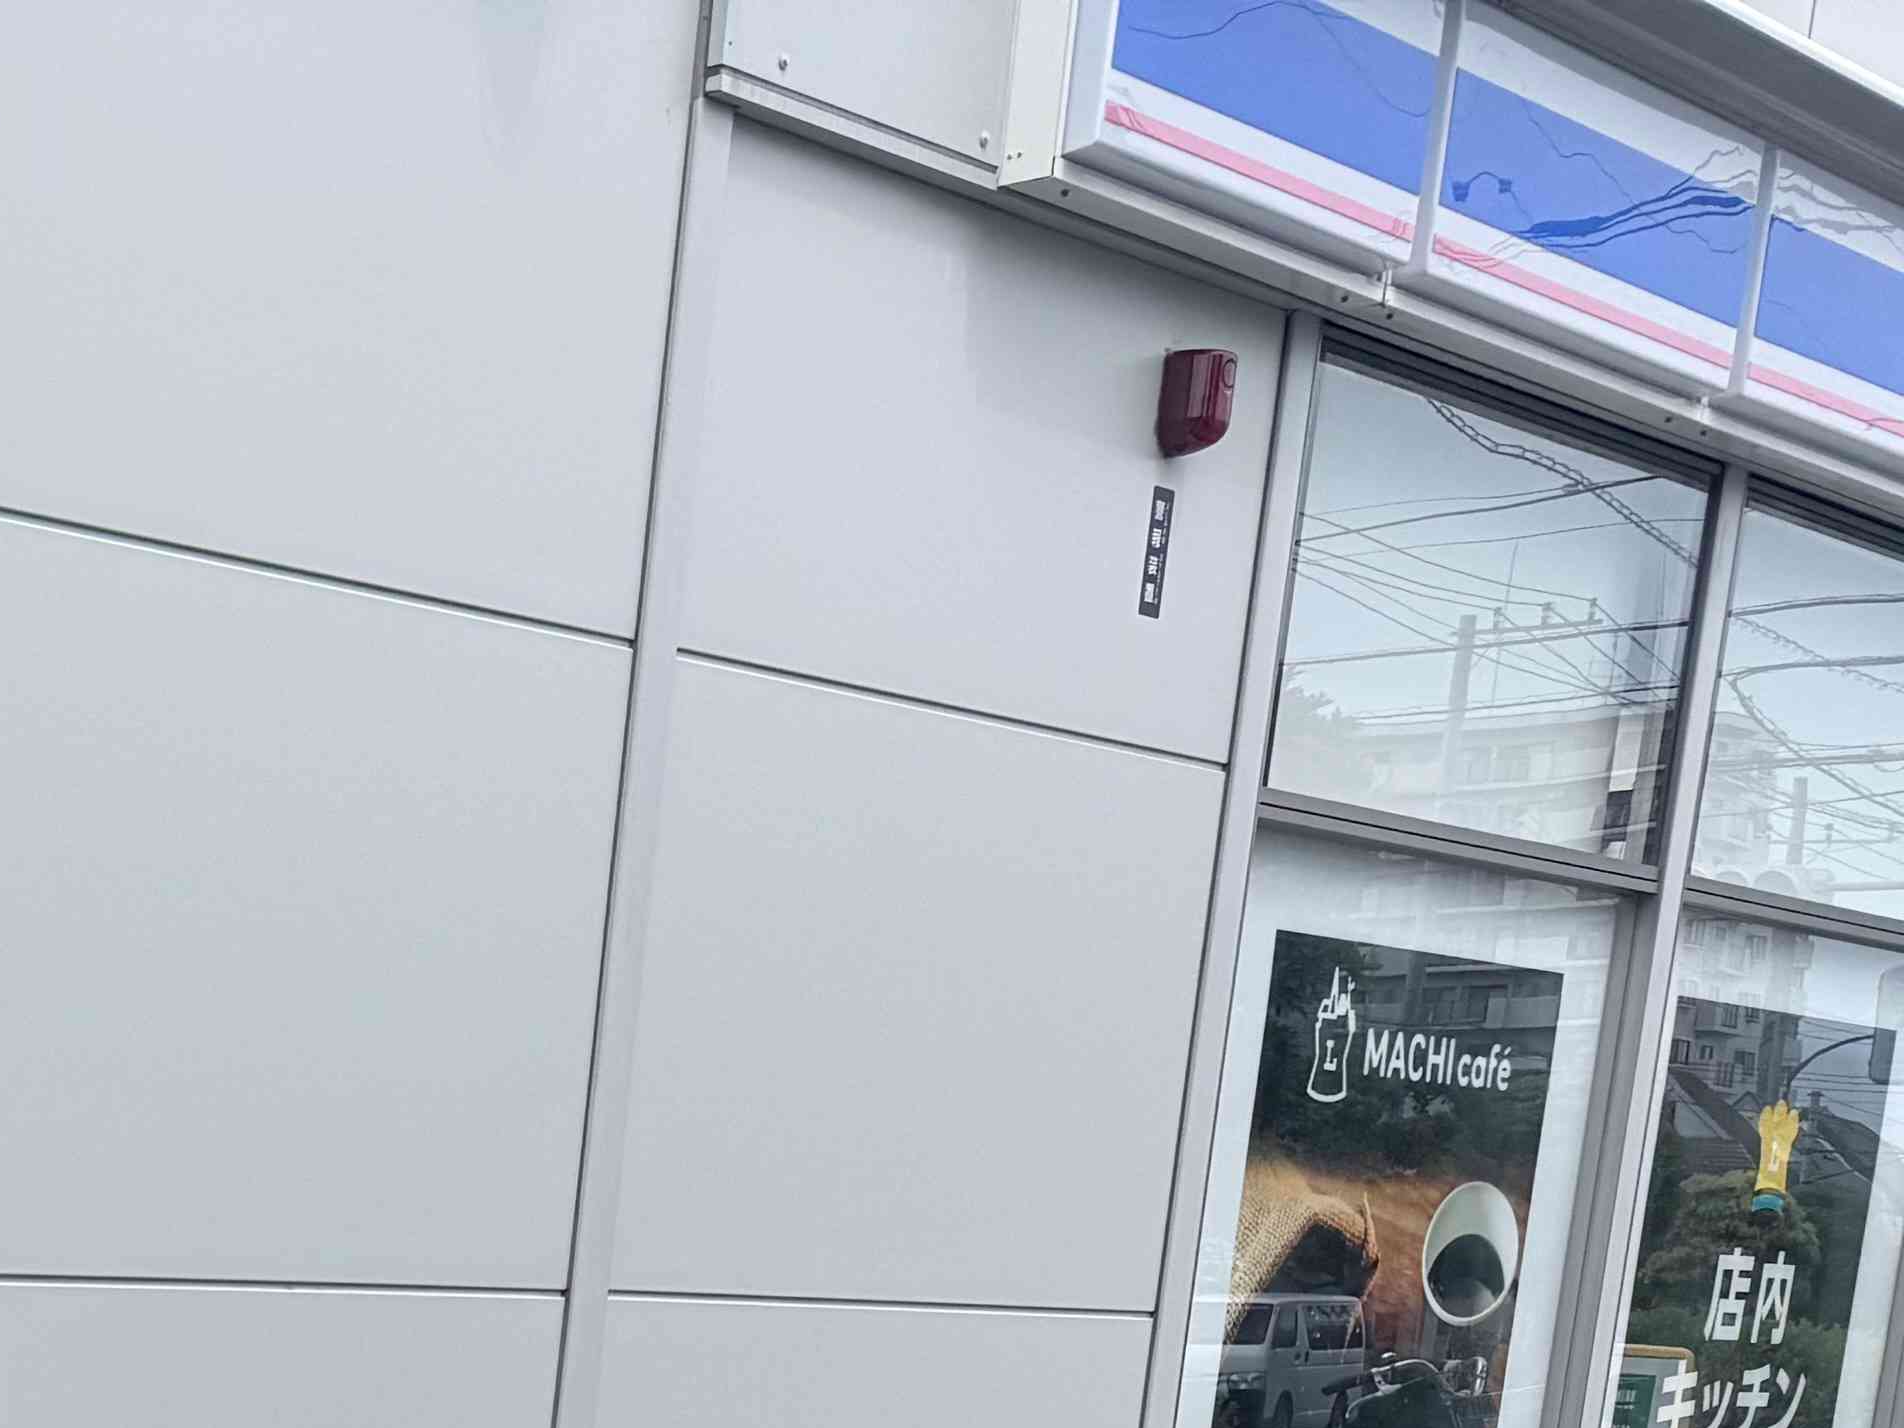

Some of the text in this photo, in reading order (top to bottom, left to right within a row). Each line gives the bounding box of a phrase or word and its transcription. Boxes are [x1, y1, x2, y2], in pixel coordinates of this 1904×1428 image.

[1362, 1027, 1512, 1091] MACHI café
[1704, 1247, 1796, 1345] 店内
